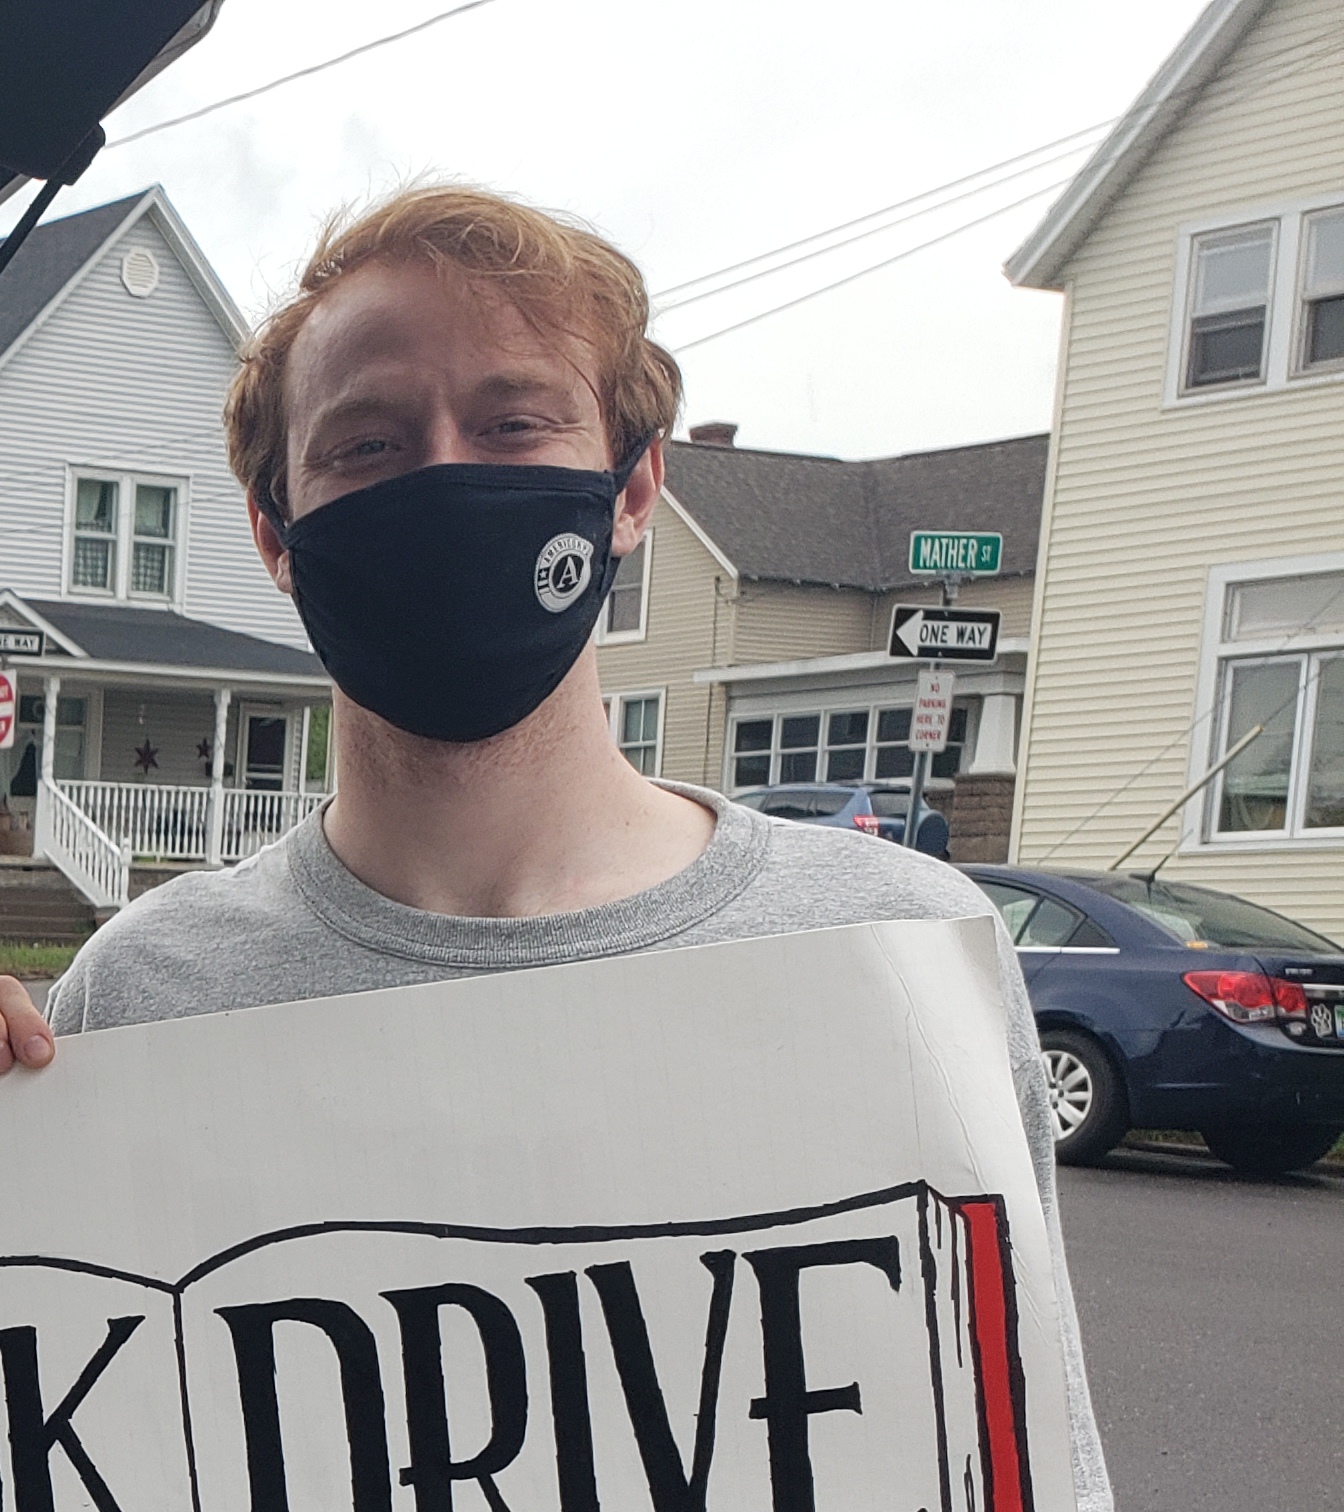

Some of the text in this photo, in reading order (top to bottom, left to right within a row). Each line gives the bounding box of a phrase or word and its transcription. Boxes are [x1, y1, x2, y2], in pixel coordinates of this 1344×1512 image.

[919, 537, 992, 569] MATHER ST
[556, 556, 579, 589] A
[15, 636, 36, 649] WAY
[919, 624, 987, 645] ONE WAY
[930, 683, 940, 693] NO
